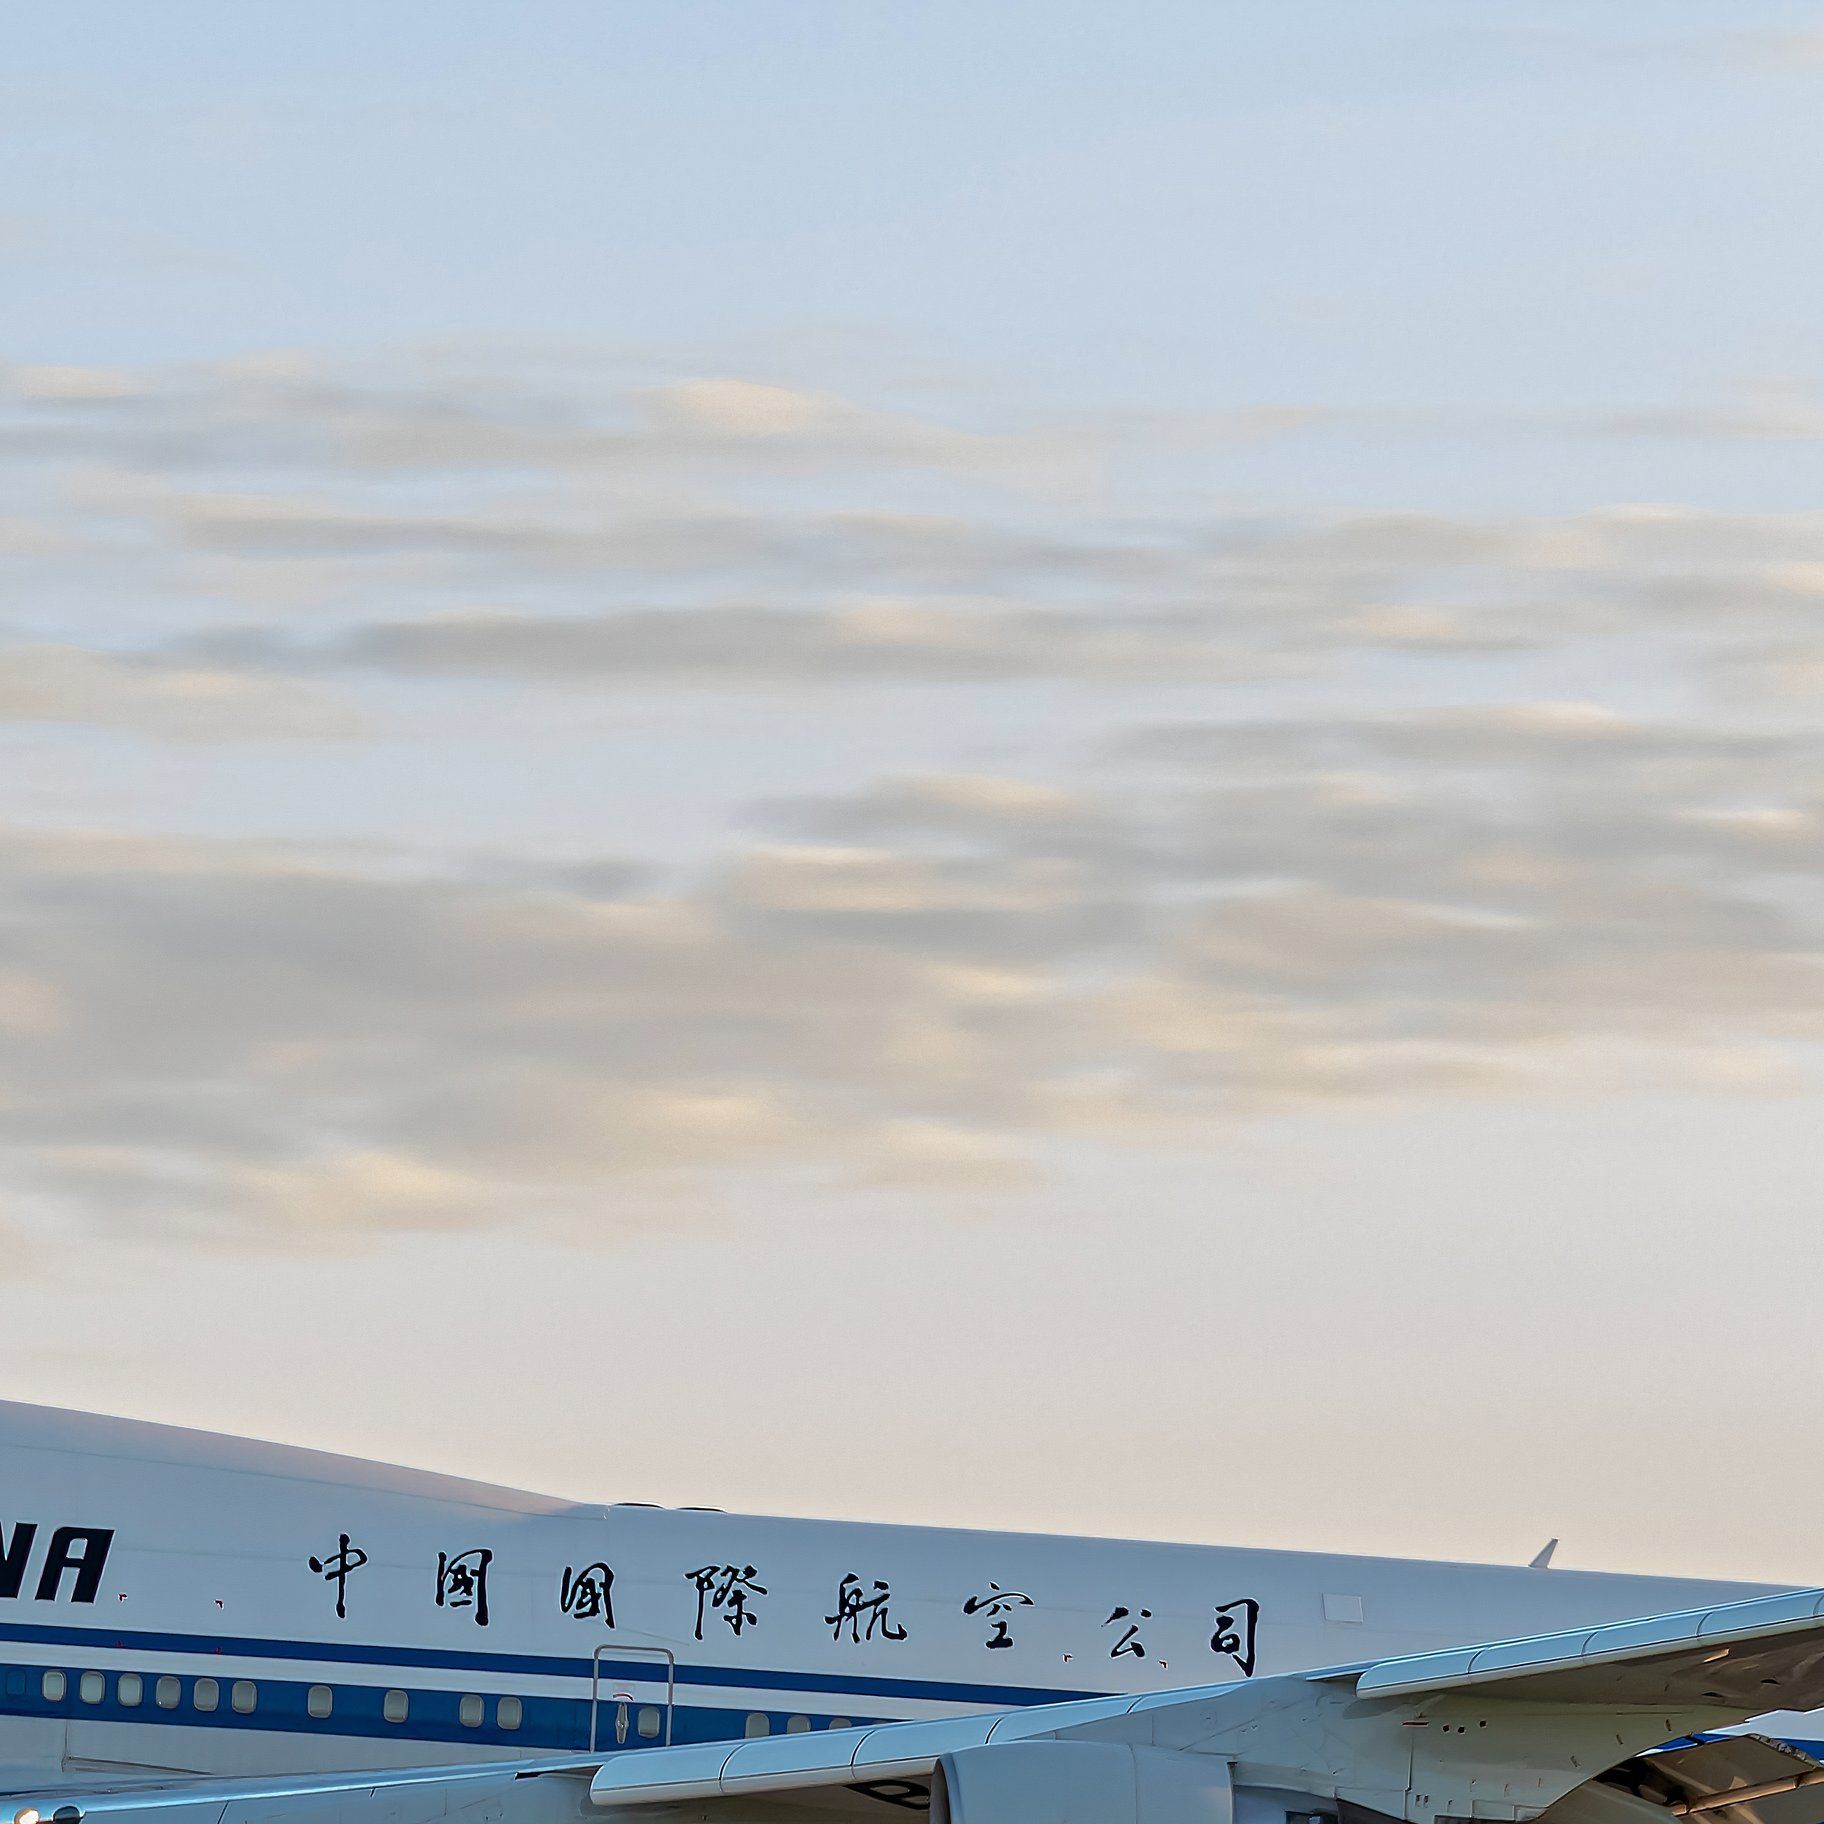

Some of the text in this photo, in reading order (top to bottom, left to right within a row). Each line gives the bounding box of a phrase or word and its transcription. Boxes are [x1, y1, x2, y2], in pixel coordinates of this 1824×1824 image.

[308, 1533, 1260, 1677] 中國國際航空公司
